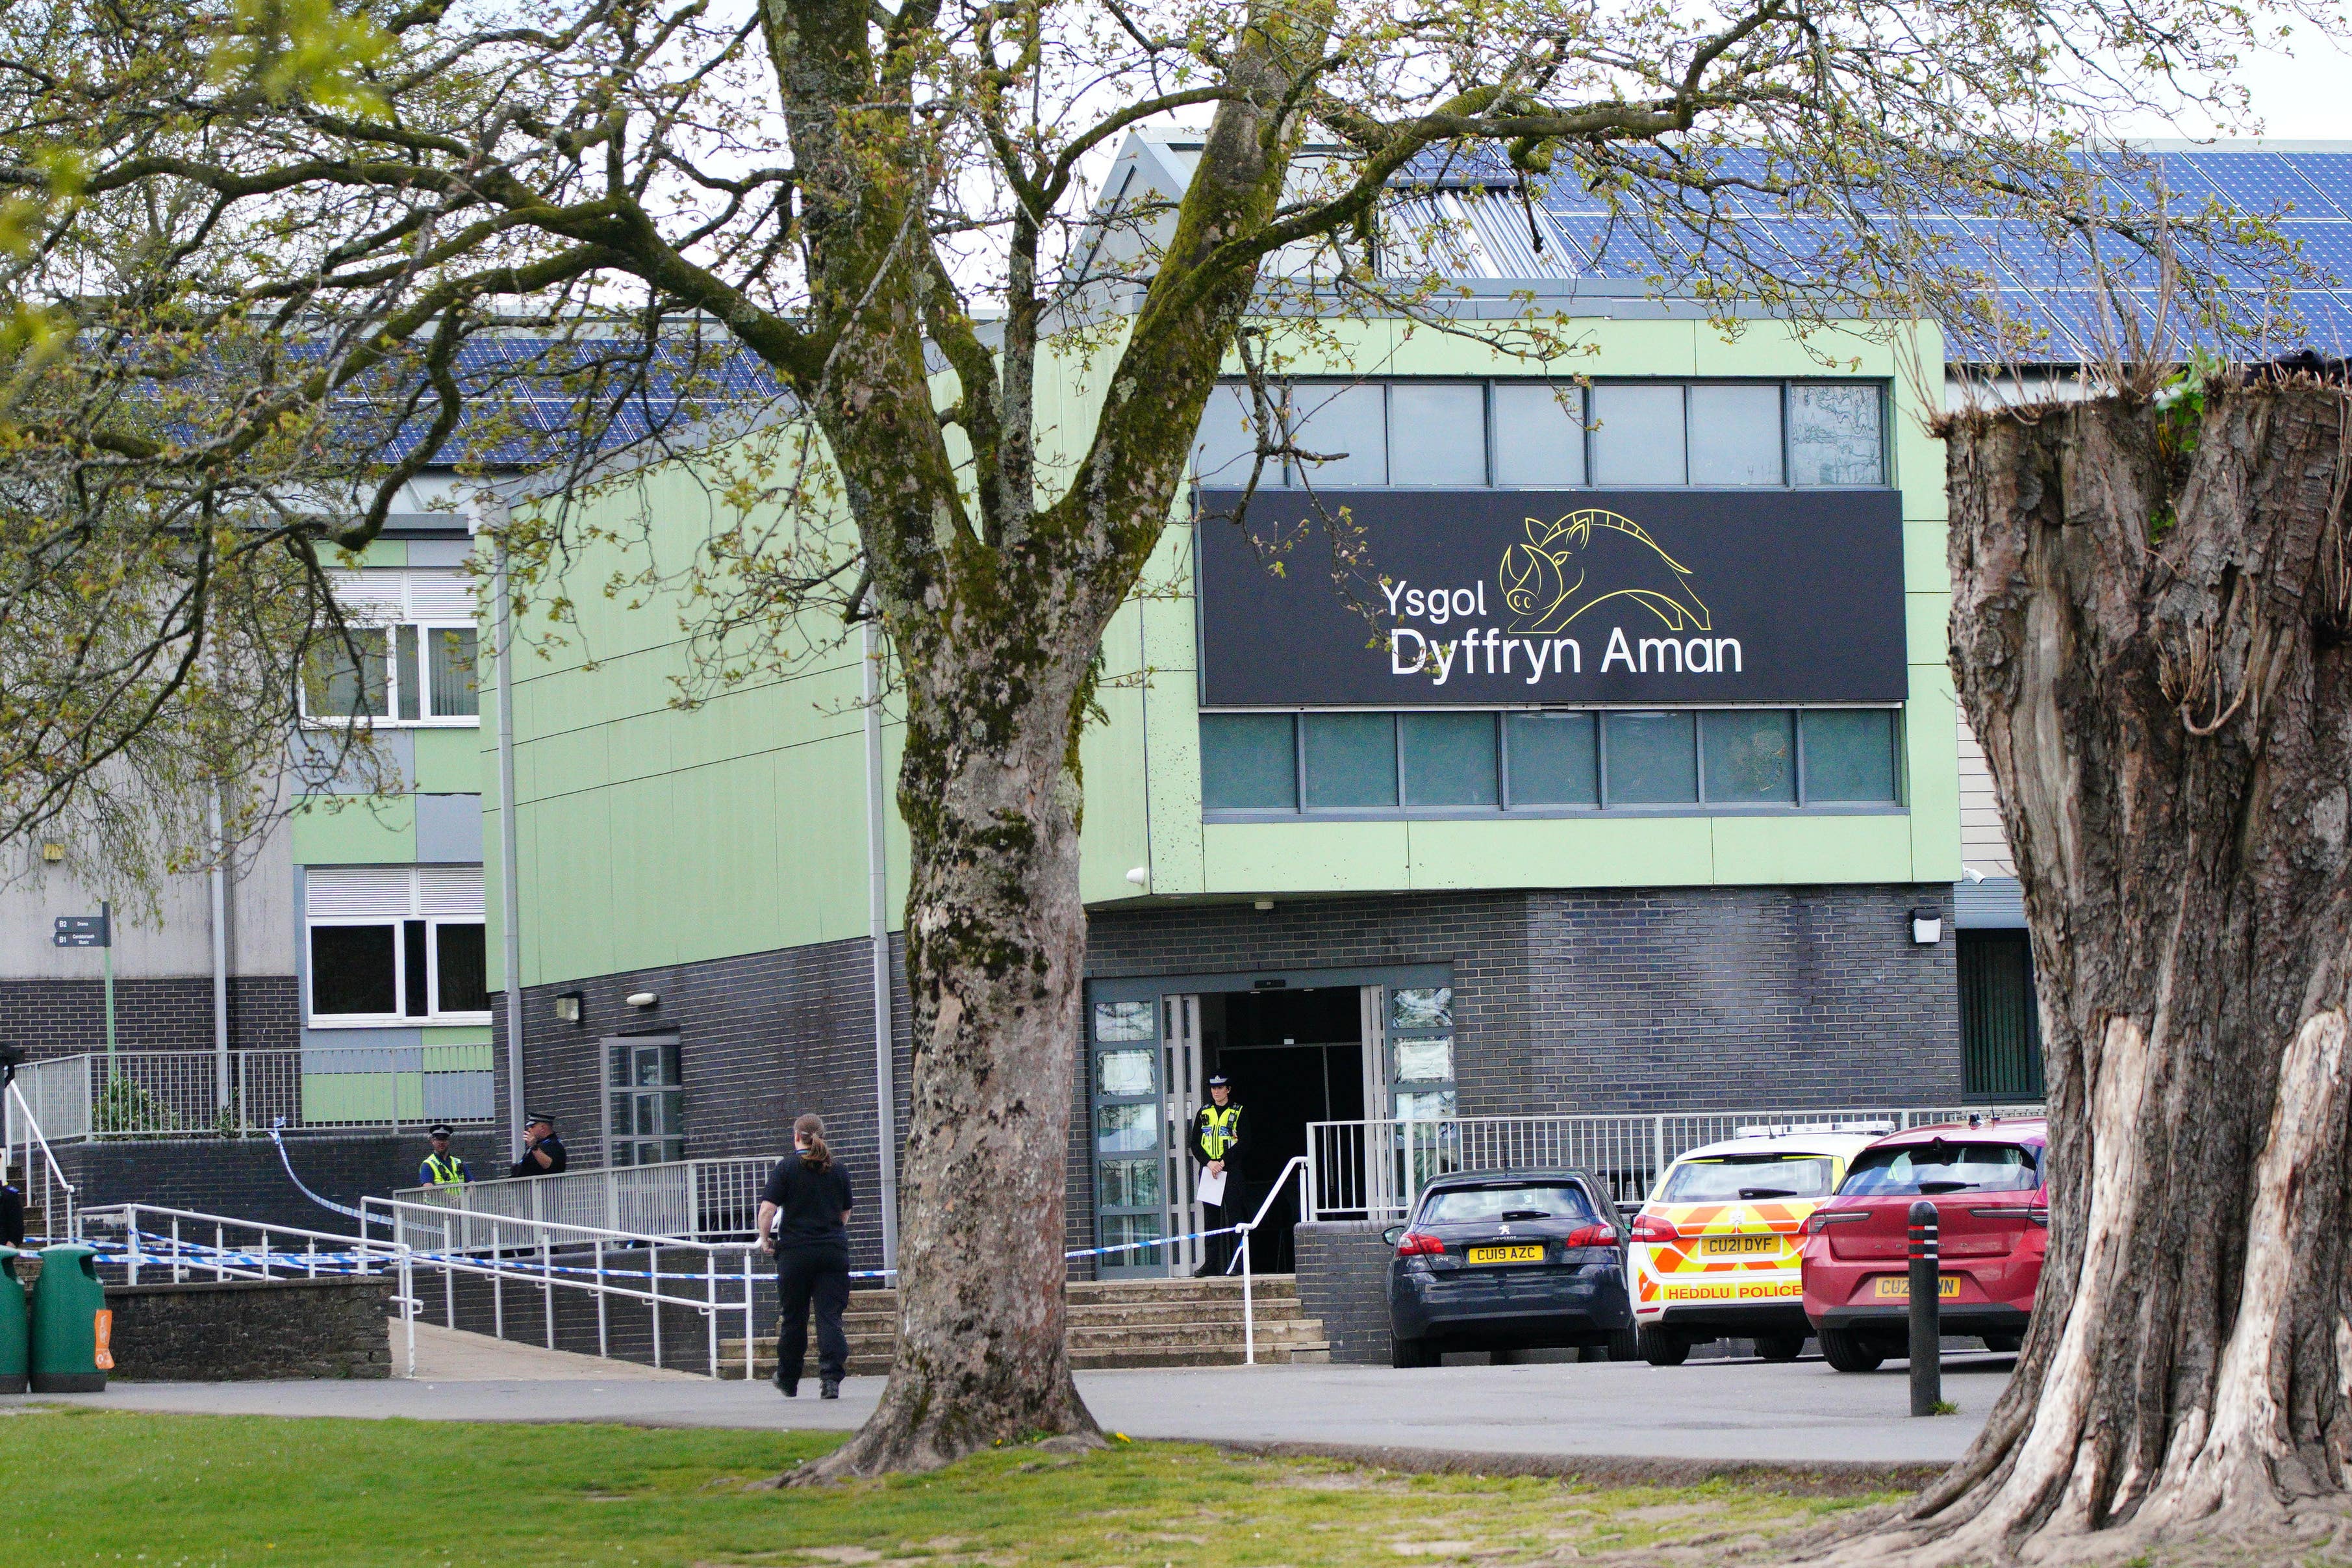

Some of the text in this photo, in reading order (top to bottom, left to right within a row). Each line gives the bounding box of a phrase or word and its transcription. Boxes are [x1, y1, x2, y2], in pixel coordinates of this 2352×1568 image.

[1381, 580, 1487, 624] Ysgol
[1391, 627, 1742, 685] Dyffryn Aman
[1709, 1237, 1772, 1252] CU21 DYF
[1477, 1246, 1536, 1260] CU19 AZC
[1669, 1285, 1803, 1300] HEDDLU POLICE
